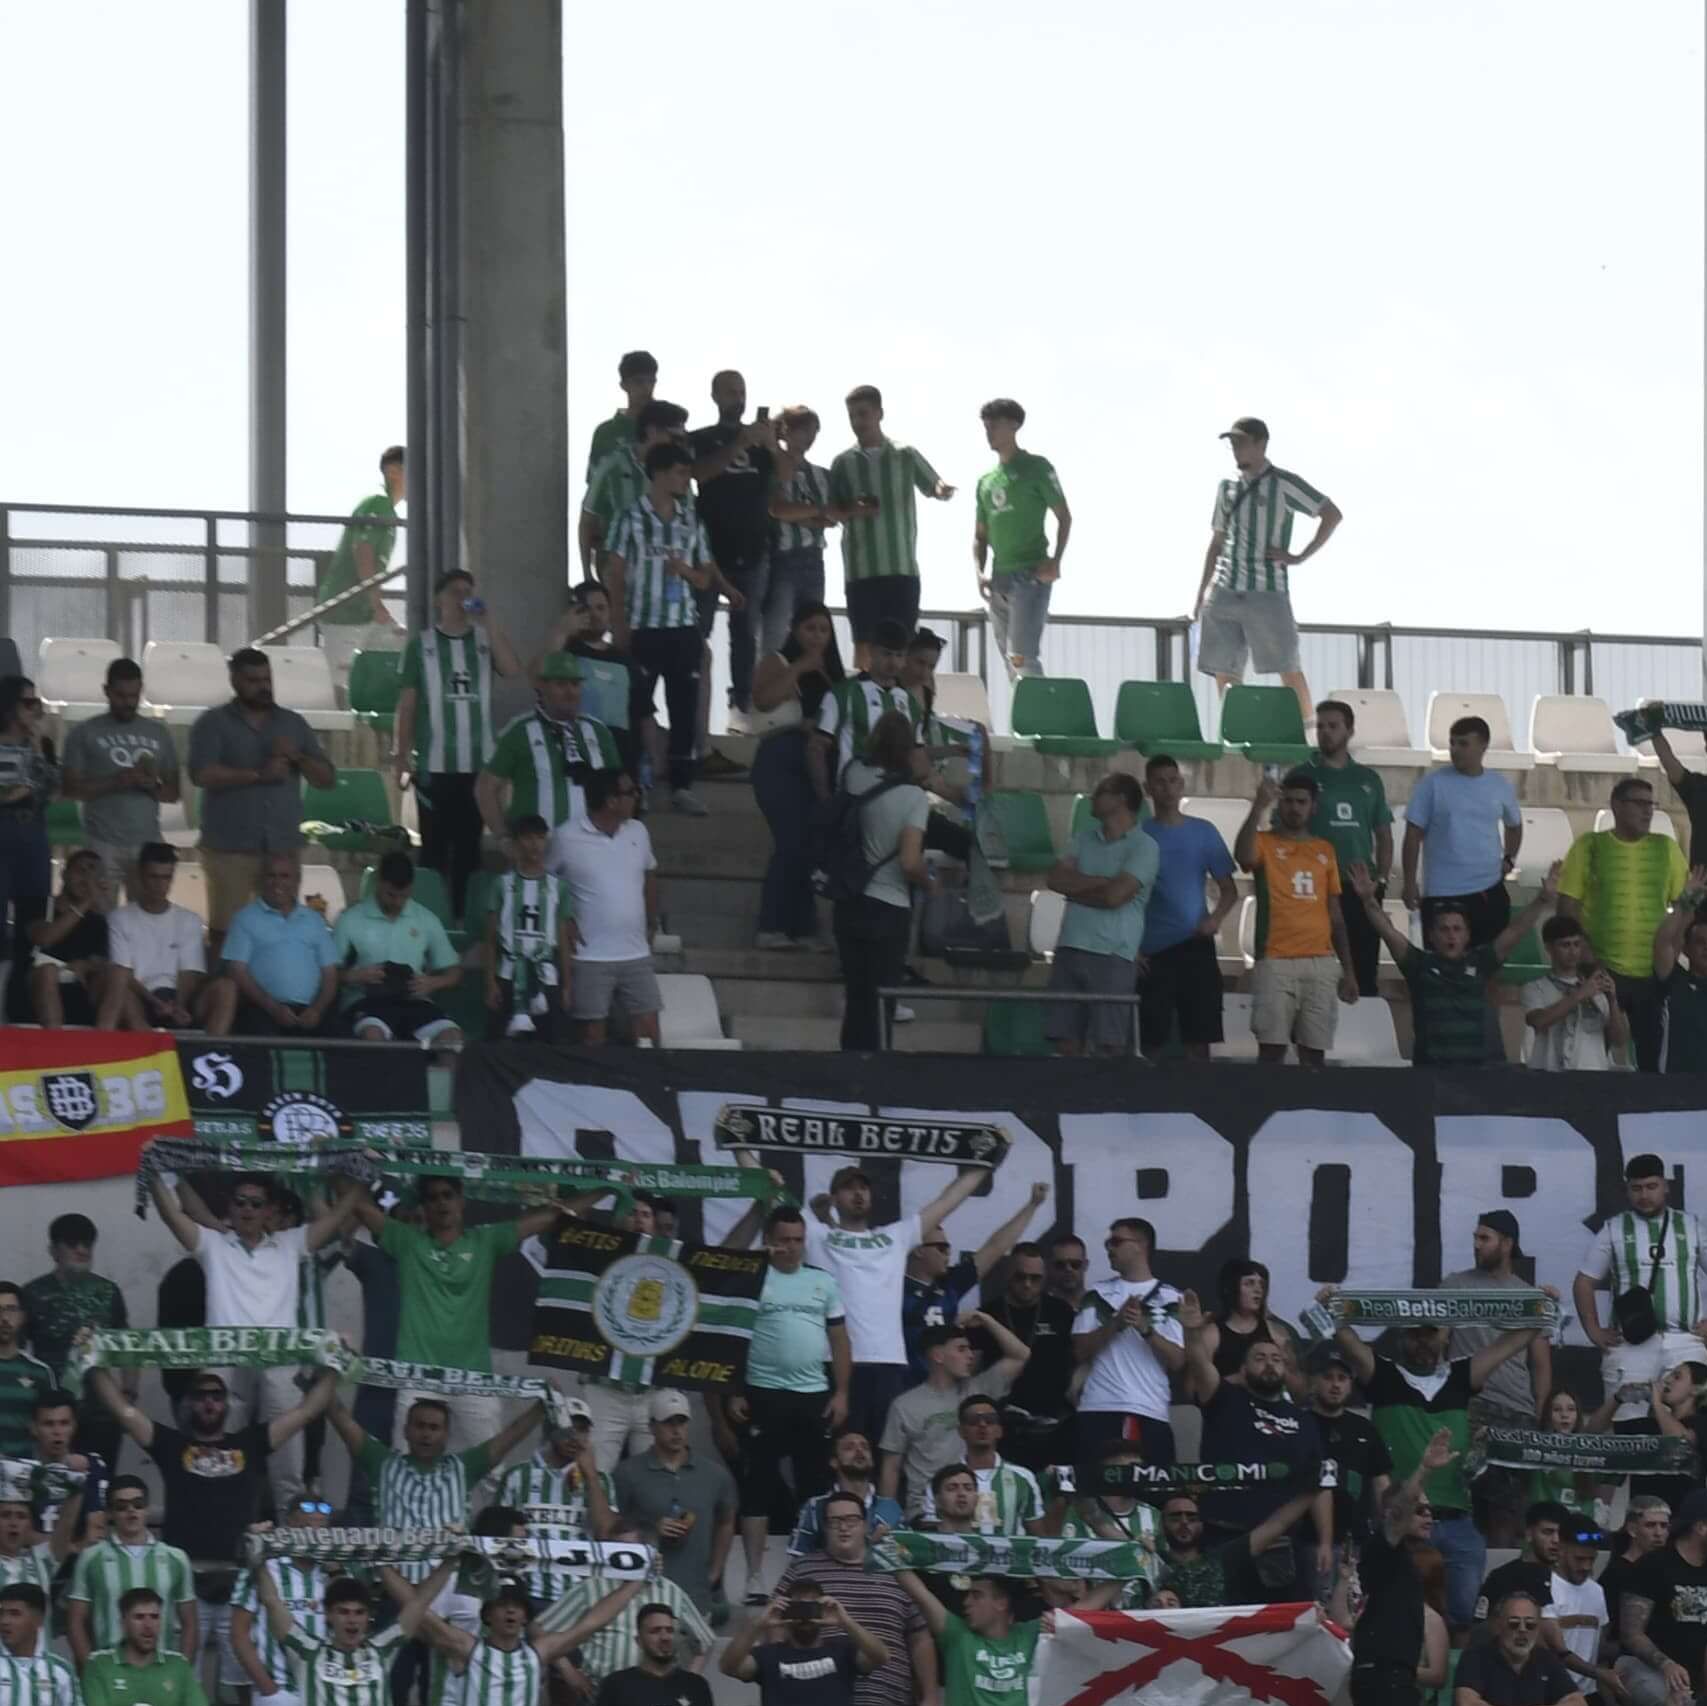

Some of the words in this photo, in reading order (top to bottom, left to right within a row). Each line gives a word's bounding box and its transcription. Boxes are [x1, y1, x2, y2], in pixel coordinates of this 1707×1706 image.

[761, 1115, 843, 1147] REAL
[858, 1124, 960, 1155] BETIS
[94, 1327, 196, 1352] REAL
[210, 1327, 322, 1351] BETIS
[1132, 1463, 1287, 1484] MANICOMIO
